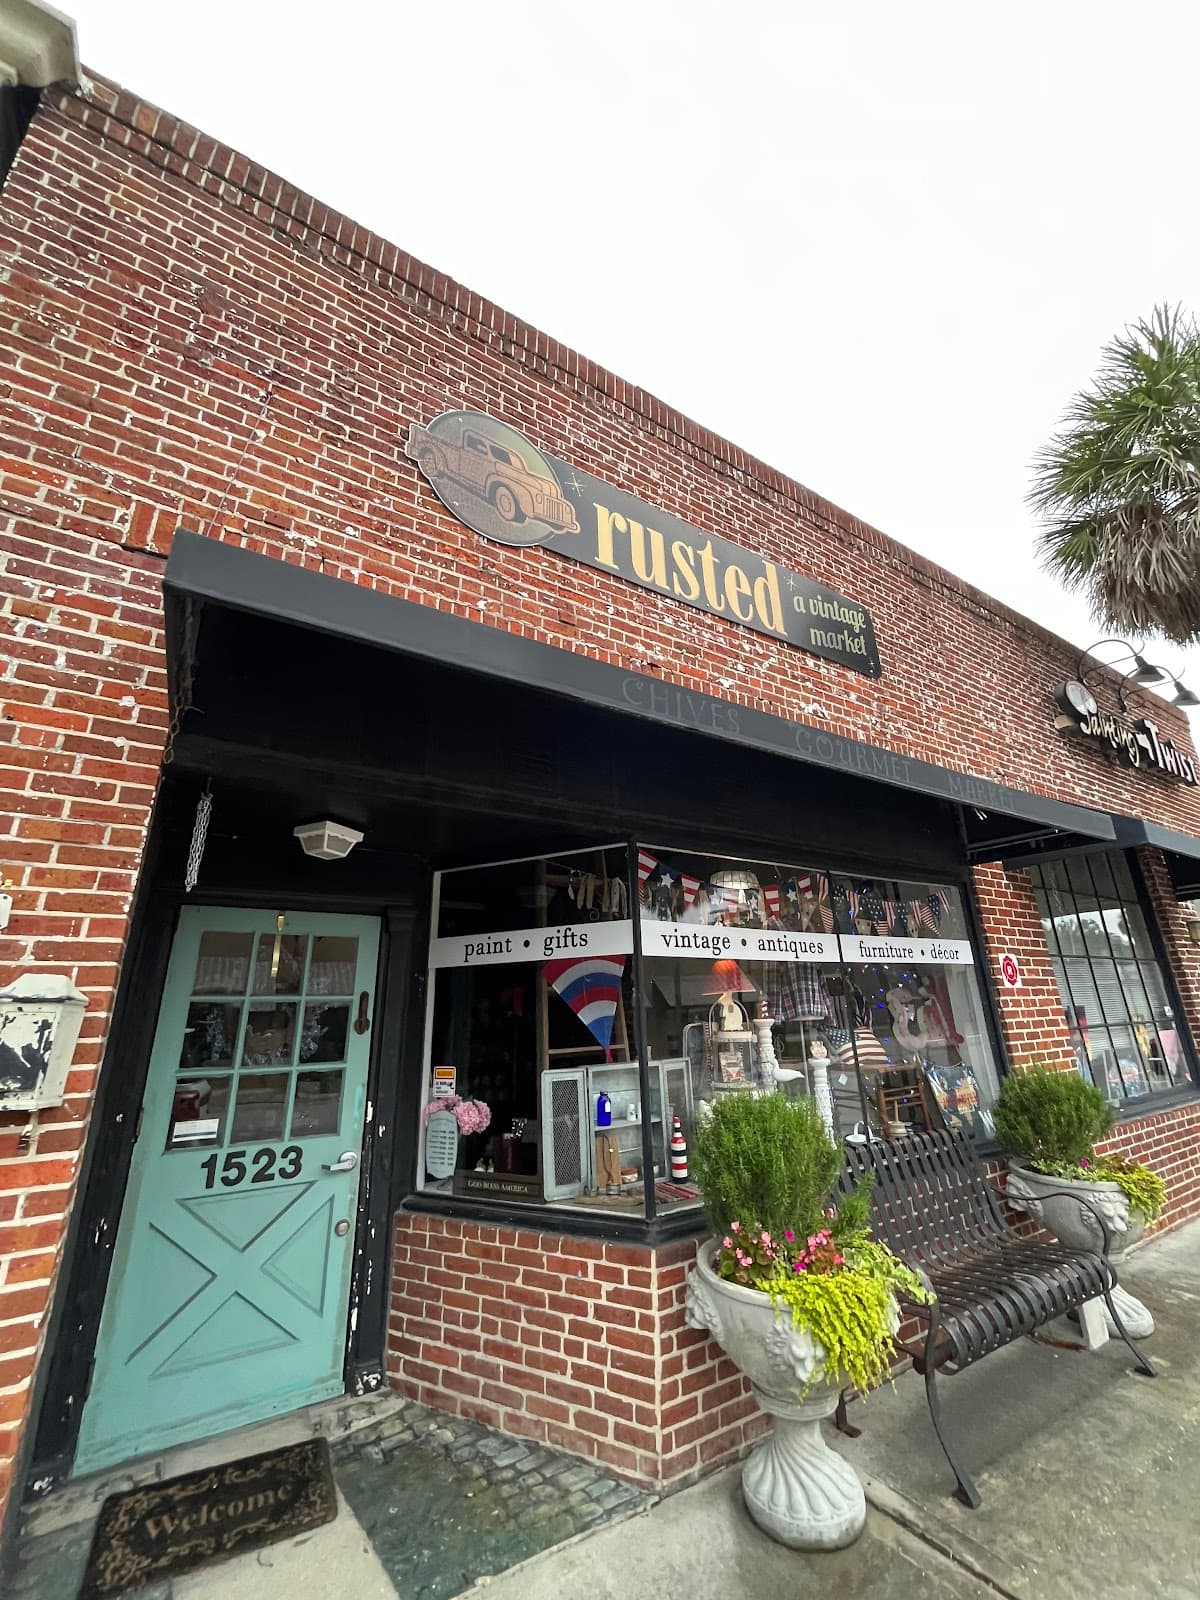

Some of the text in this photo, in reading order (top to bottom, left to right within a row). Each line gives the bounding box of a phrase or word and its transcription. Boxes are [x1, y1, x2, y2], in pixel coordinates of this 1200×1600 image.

[593, 502, 788, 636] rusted
[793, 595, 867, 634] a vintage
[810, 627, 868, 656] market
[621, 677, 741, 737] CHIVES
[794, 727, 914, 785] GOURMET
[463, 927, 588, 962] paint gifts
[660, 928, 824, 960] vintage antiques
[858, 941, 959, 959] furniture décor
[200, 1145, 304, 1190] 1523
[144, 1484, 293, 1539] Welcome
